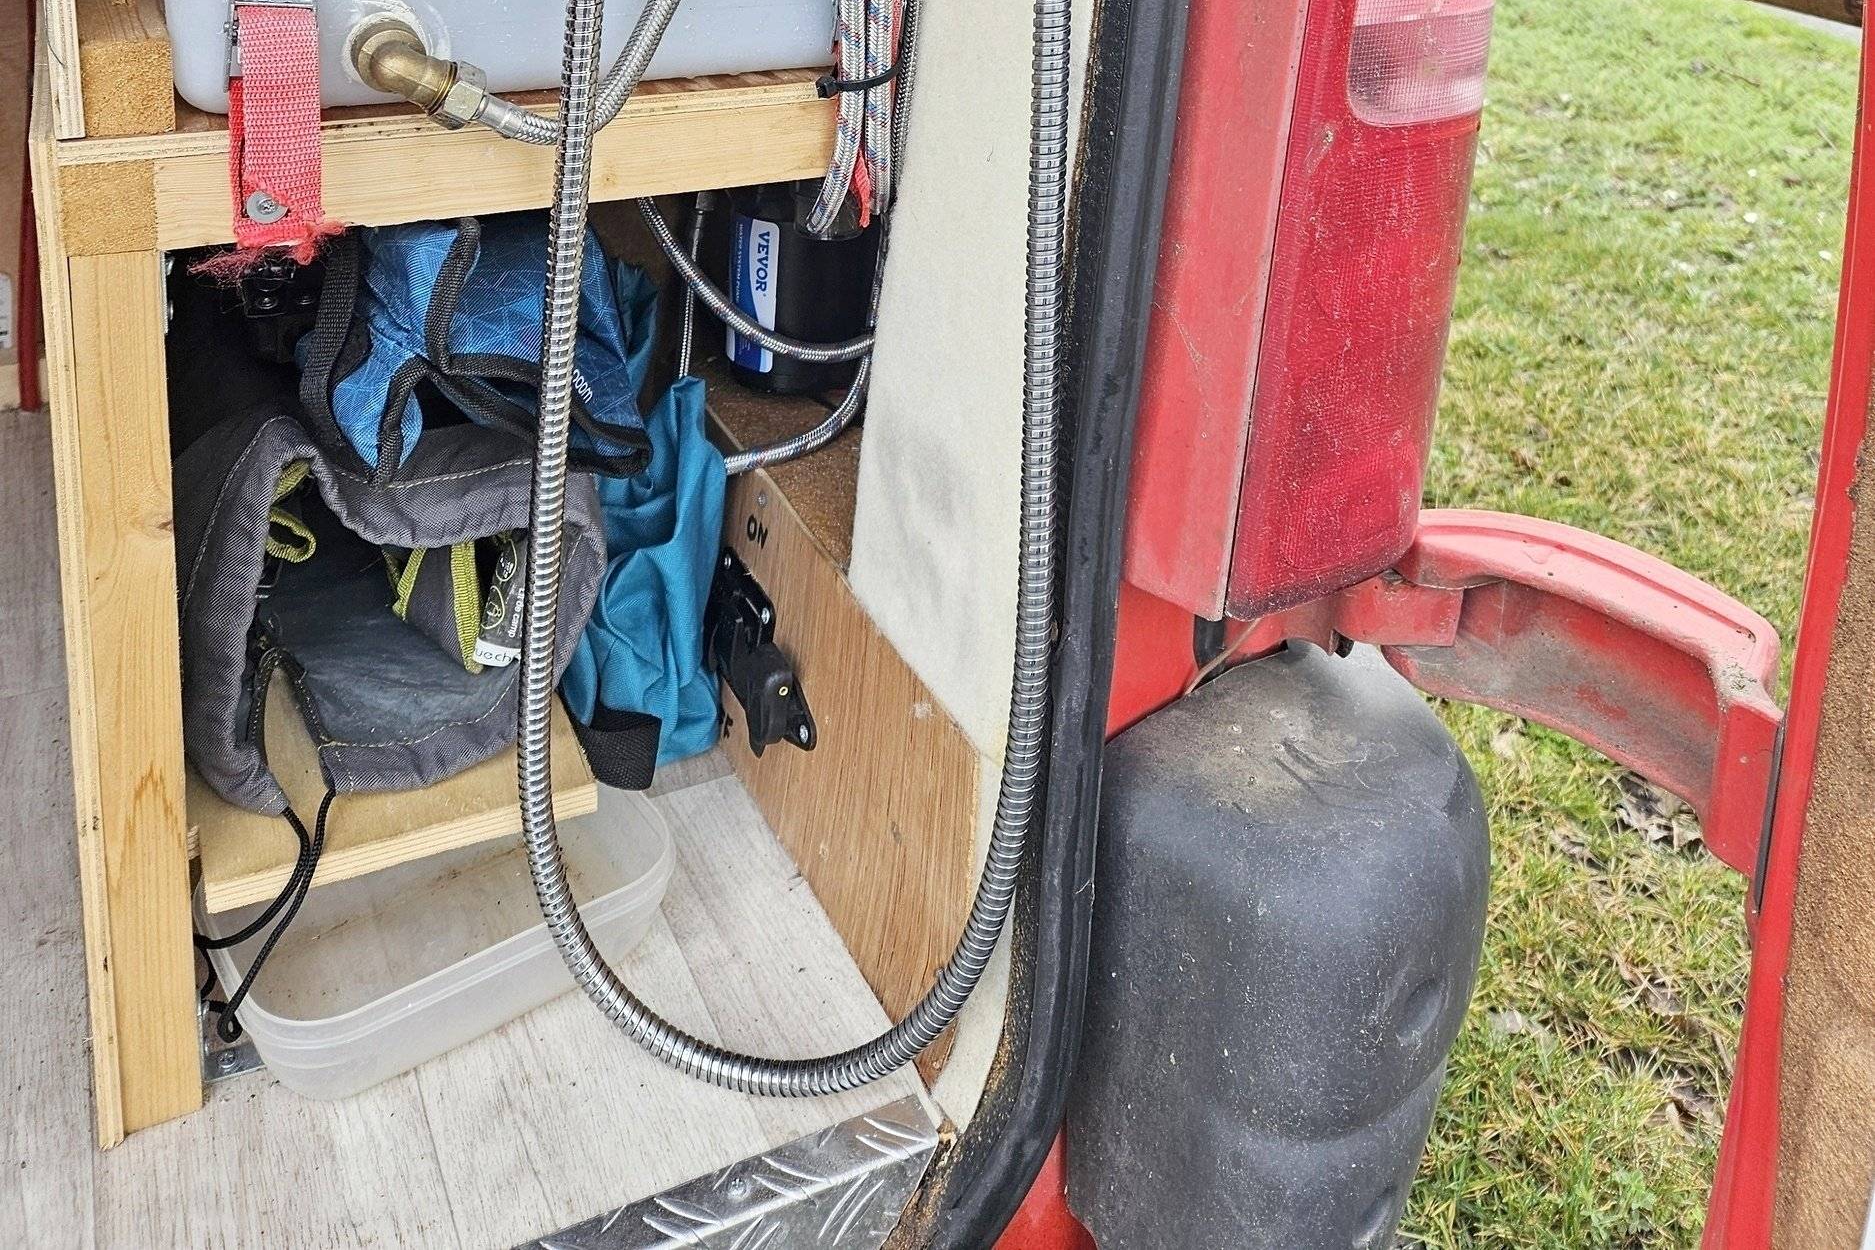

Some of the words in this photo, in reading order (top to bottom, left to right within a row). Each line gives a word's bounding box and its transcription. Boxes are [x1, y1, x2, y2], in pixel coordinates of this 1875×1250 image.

[756, 231, 770, 291] VEVOR
[746, 514, 769, 549] ON
[508, 613, 519, 637] camp
